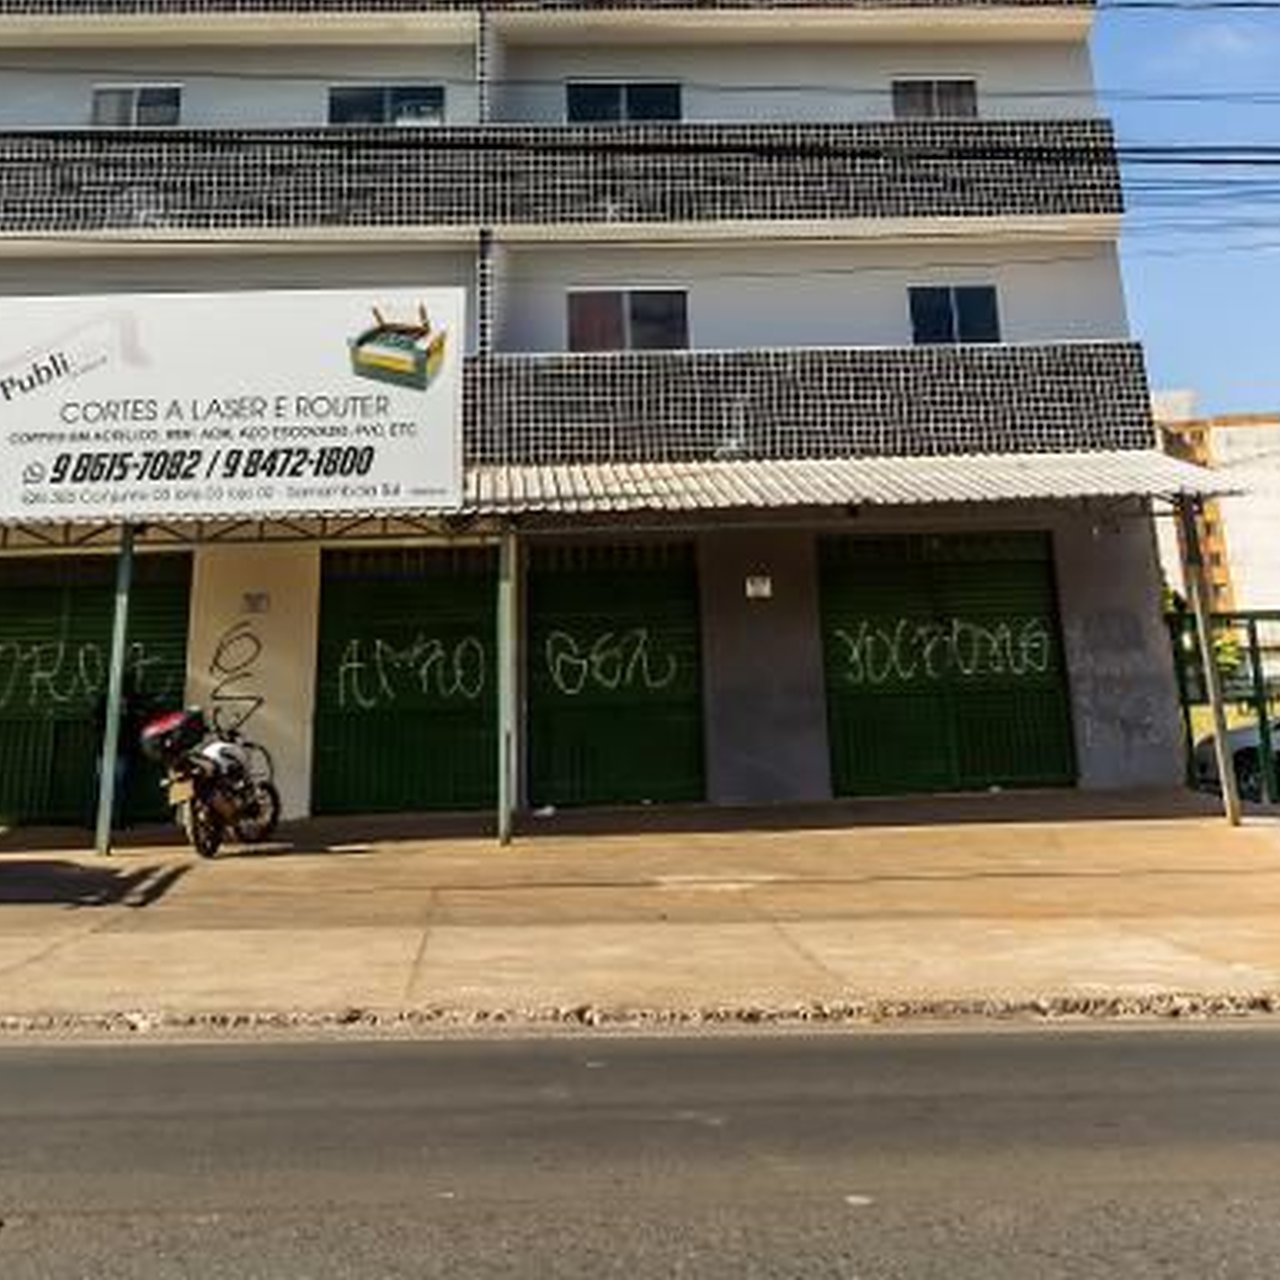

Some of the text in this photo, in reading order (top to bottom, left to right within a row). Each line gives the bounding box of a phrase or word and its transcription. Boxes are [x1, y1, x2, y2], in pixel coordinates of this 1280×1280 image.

[0, 352, 70, 401] Publi
[60, 395, 391, 423] CORTES A LASER E ROUTER
[50, 445, 374, 484] 9 8615-7082 / 9 8472-1800
